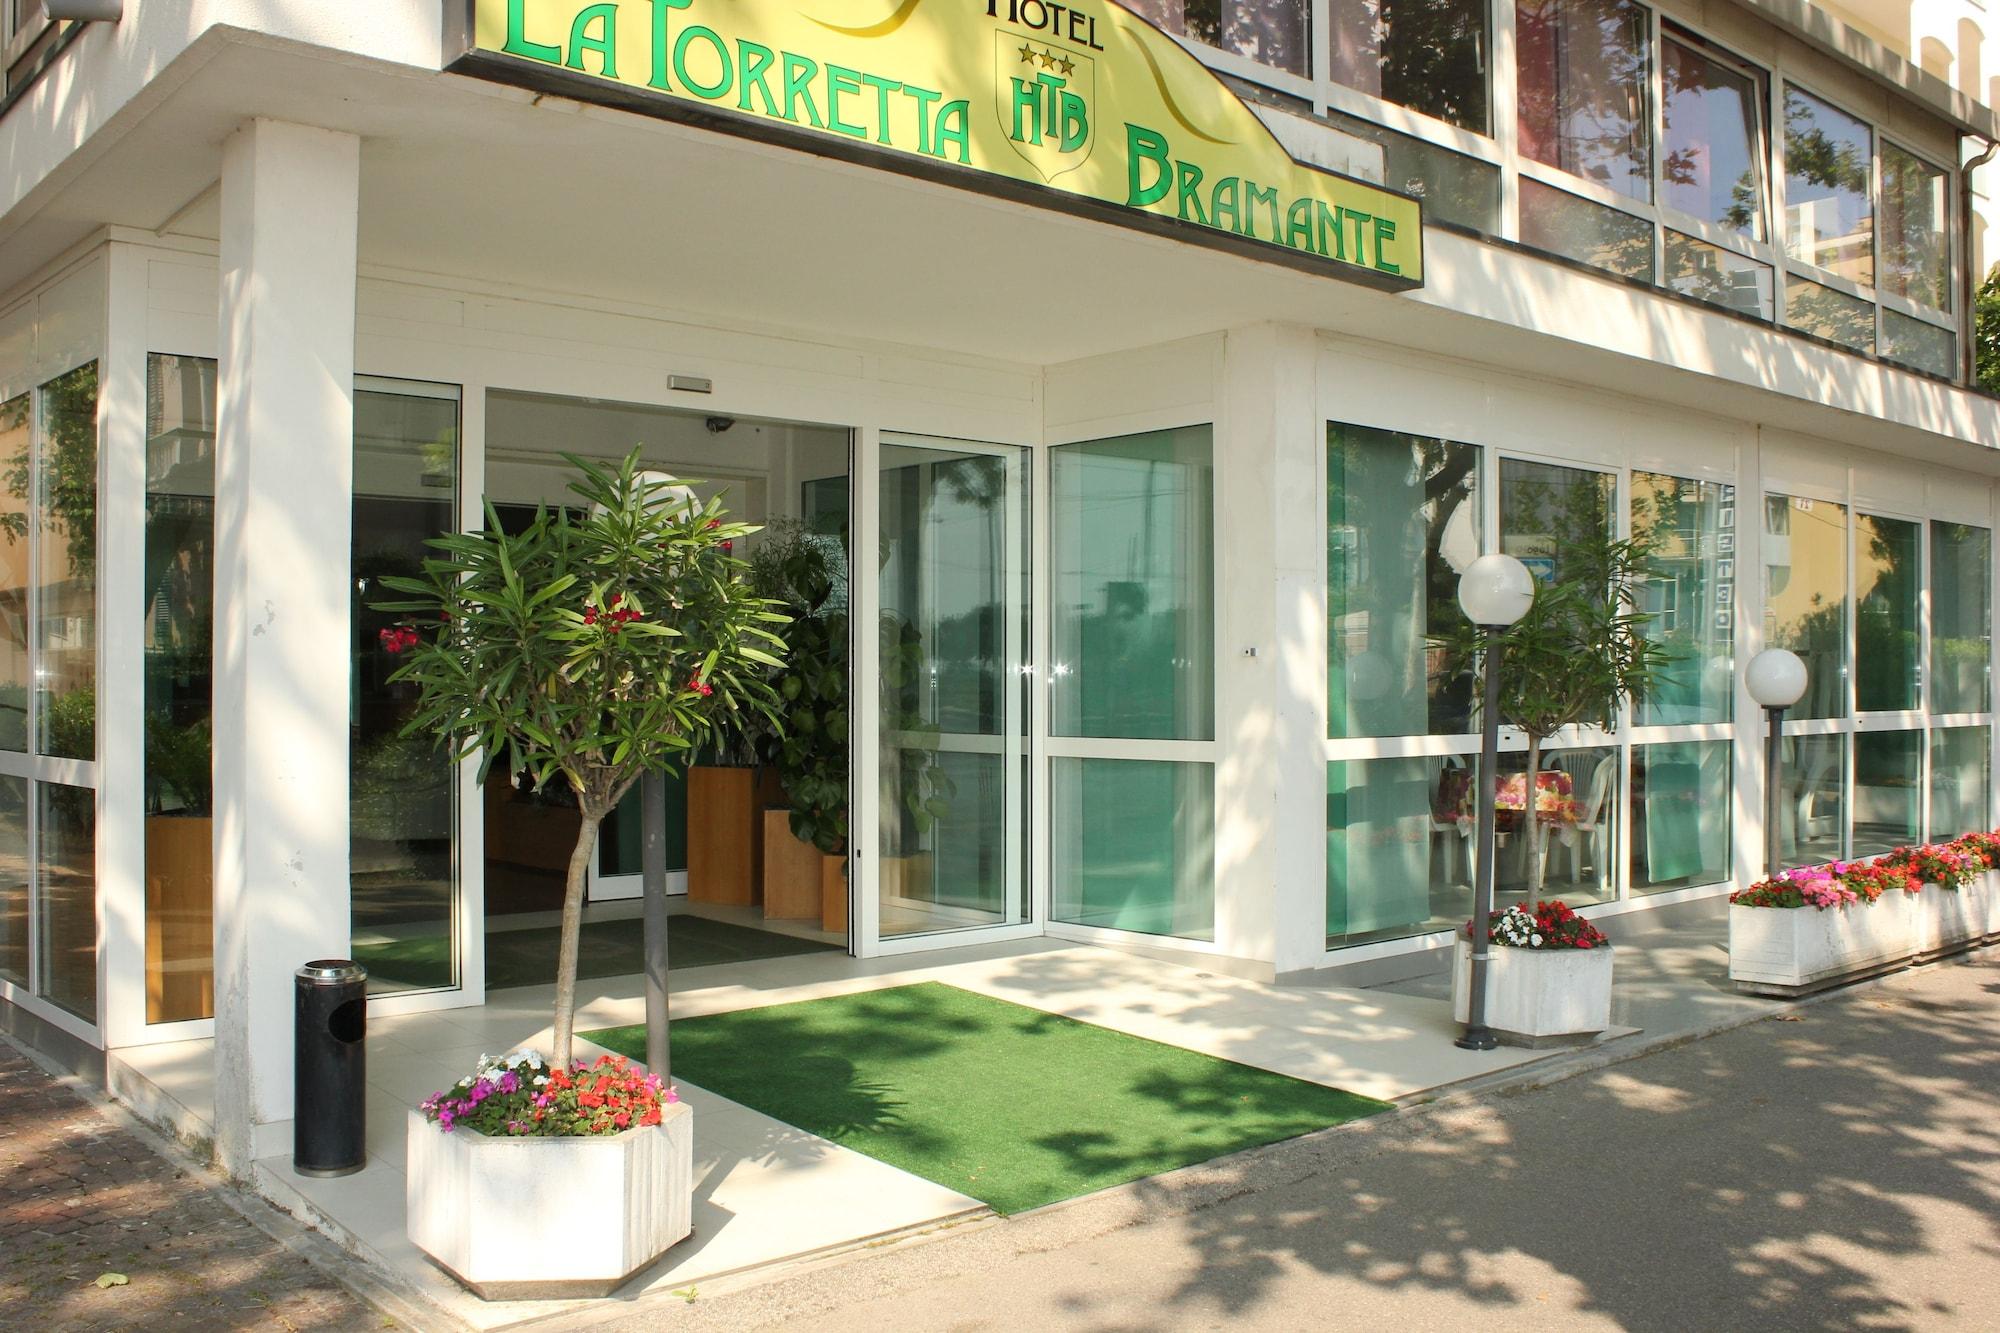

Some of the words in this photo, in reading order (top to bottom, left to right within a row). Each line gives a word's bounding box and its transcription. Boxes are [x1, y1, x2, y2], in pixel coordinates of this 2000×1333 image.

[501, 0, 619, 79] LA
[646, 0, 973, 165] TORRETTA
[1009, 72, 1089, 154] HTB
[1124, 122, 1400, 274] BRAMANTE
